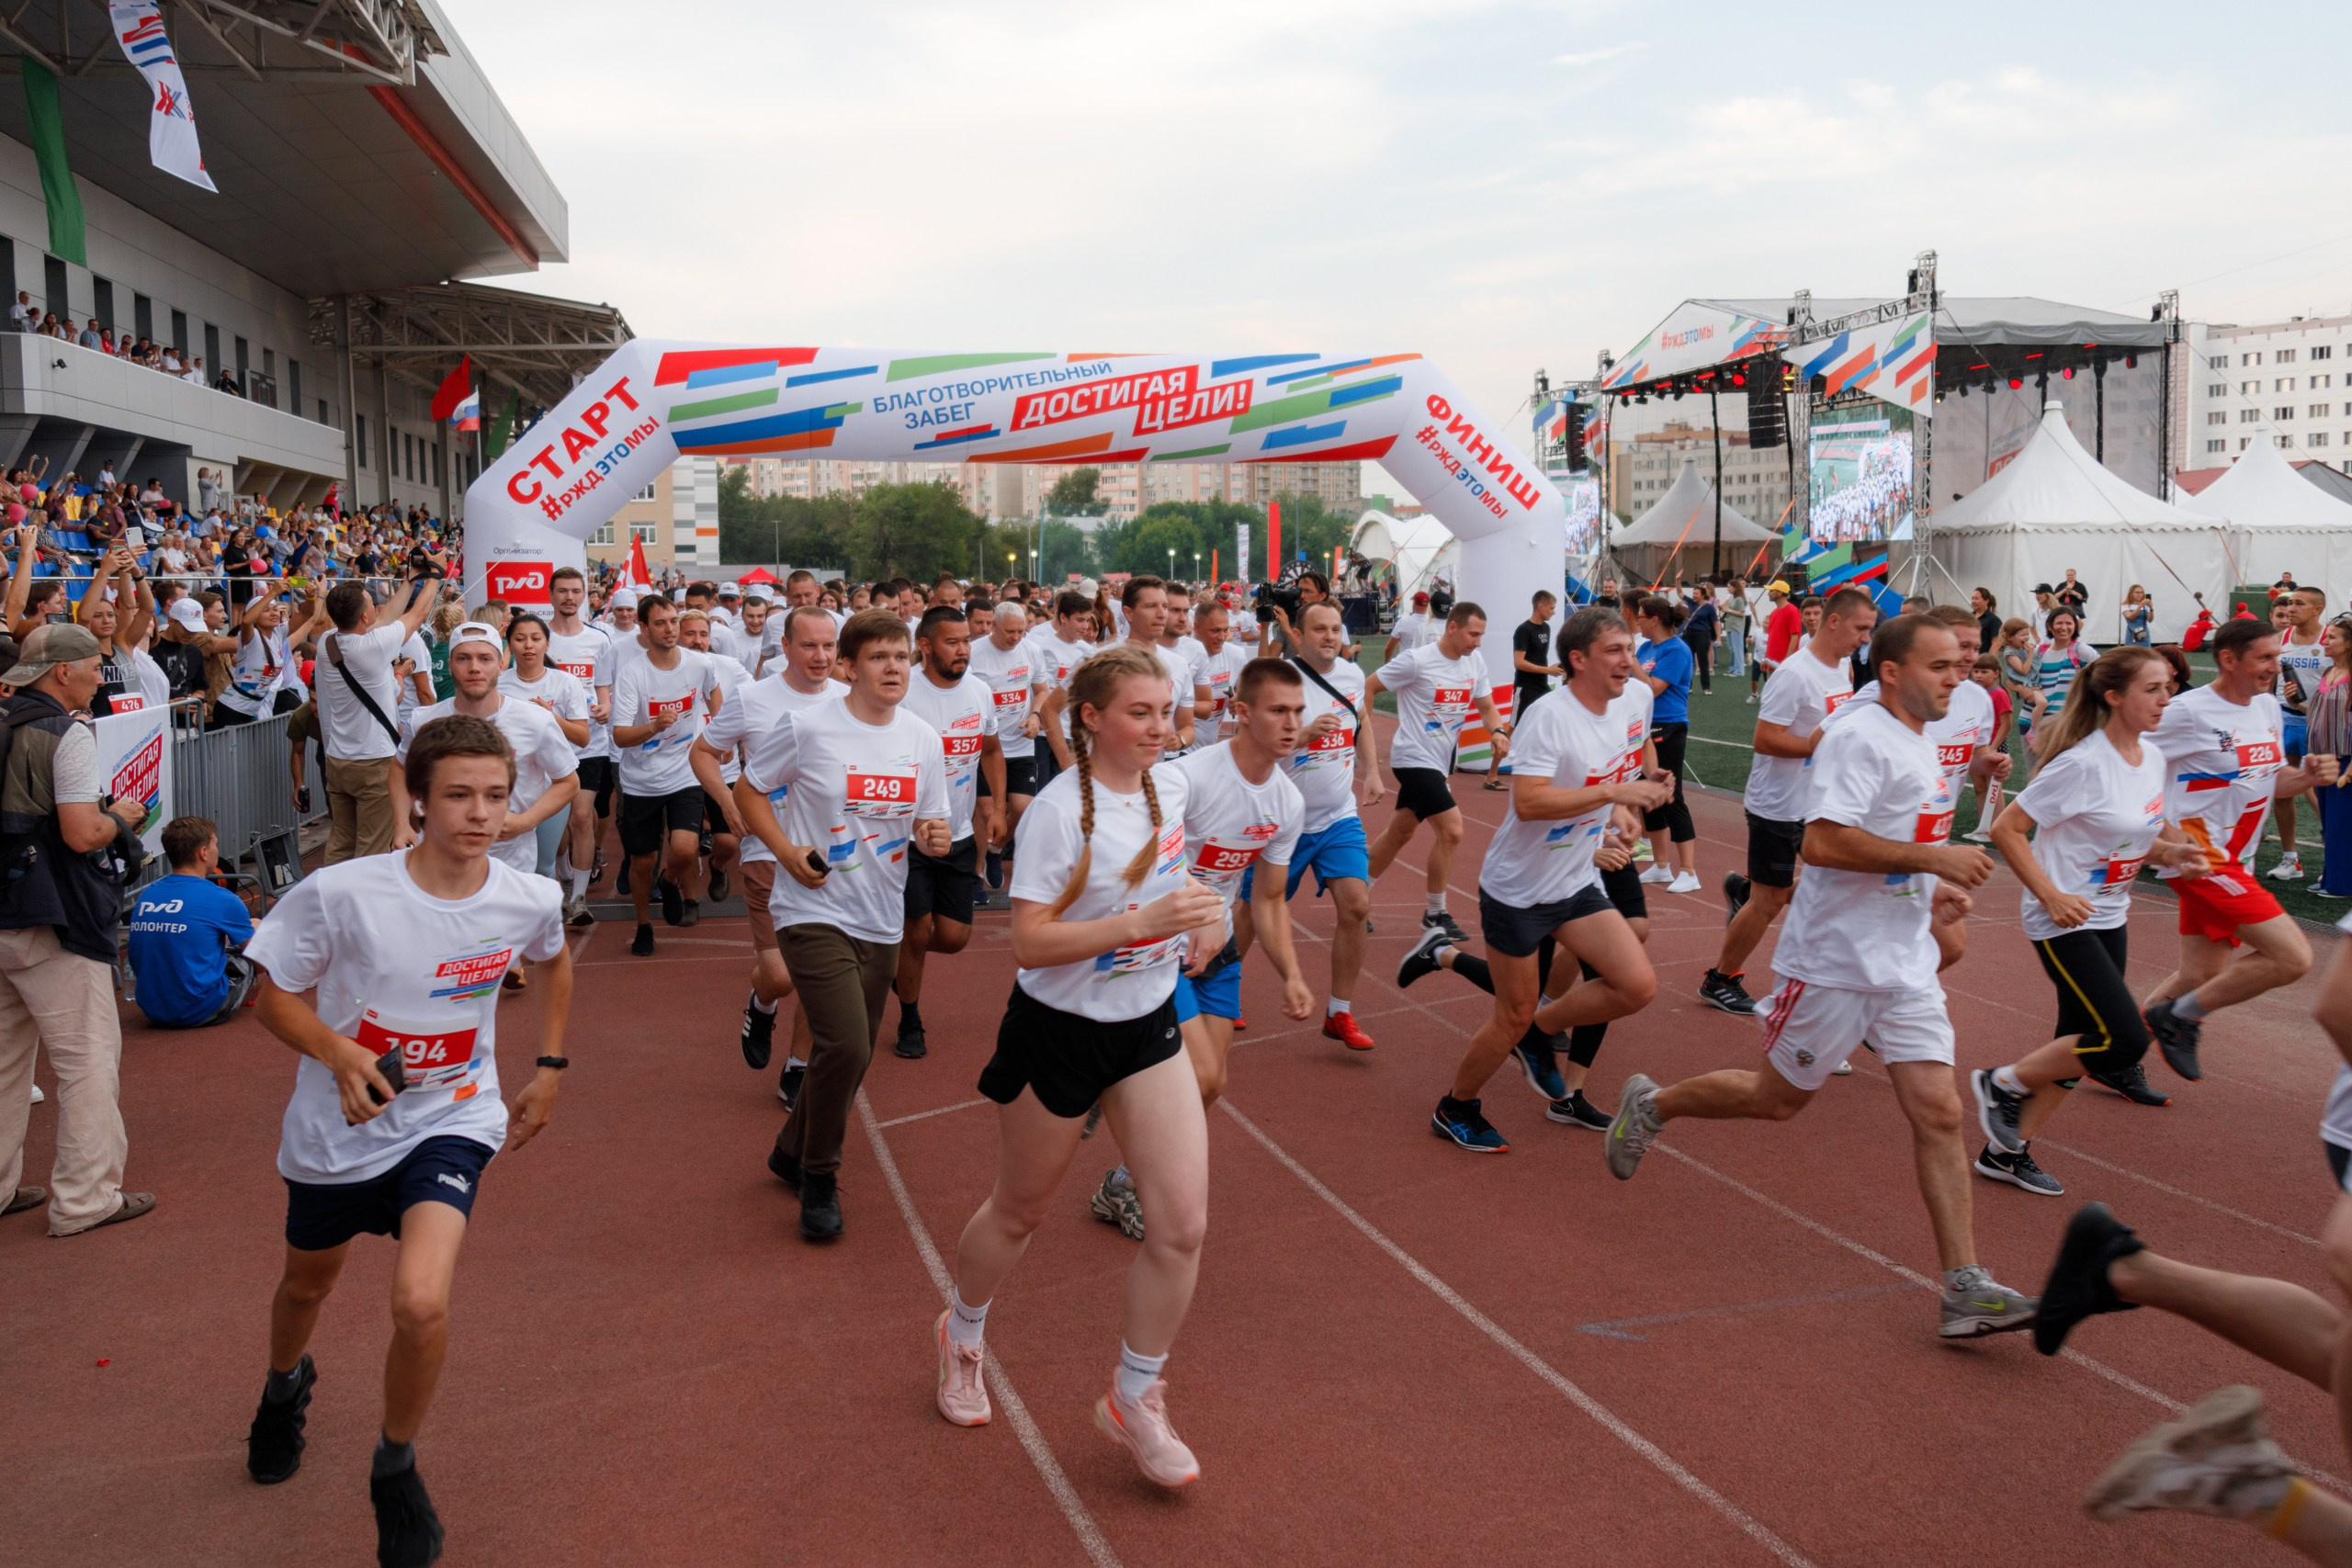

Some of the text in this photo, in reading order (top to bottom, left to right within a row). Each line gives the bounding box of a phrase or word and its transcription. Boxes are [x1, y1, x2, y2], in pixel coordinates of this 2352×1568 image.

[873, 361, 1113, 413] БЛАГОТВОРИТЕЛЬНЫЙ
[1020, 370, 1187, 428] ДОСТИГАЯ
[1140, 383, 1247, 431] ЦЕЛИ!
[904, 402, 976, 429] ЗАБЕГ
[507, 376, 639, 504] СТАРТ
[1427, 394, 1541, 511] ФИНИШ
[566, 666, 586, 676] 102
[121, 700, 140, 710] 476
[1001, 693, 1021, 704] 334
[1444, 691, 1463, 702] 347
[952, 739, 978, 752] 357
[1939, 748, 1964, 762] 345
[2249, 746, 2274, 762] 226
[114, 740, 159, 799] ДОСТИГАЯ
[864, 778, 900, 799] 249
[1215, 852, 1252, 867] 293
[130, 921, 187, 934] ВОЛОНТЕР
[441, 952, 509, 976] ДОСТИГАЯ
[460, 964, 505, 985] ЦЕЛИ!
